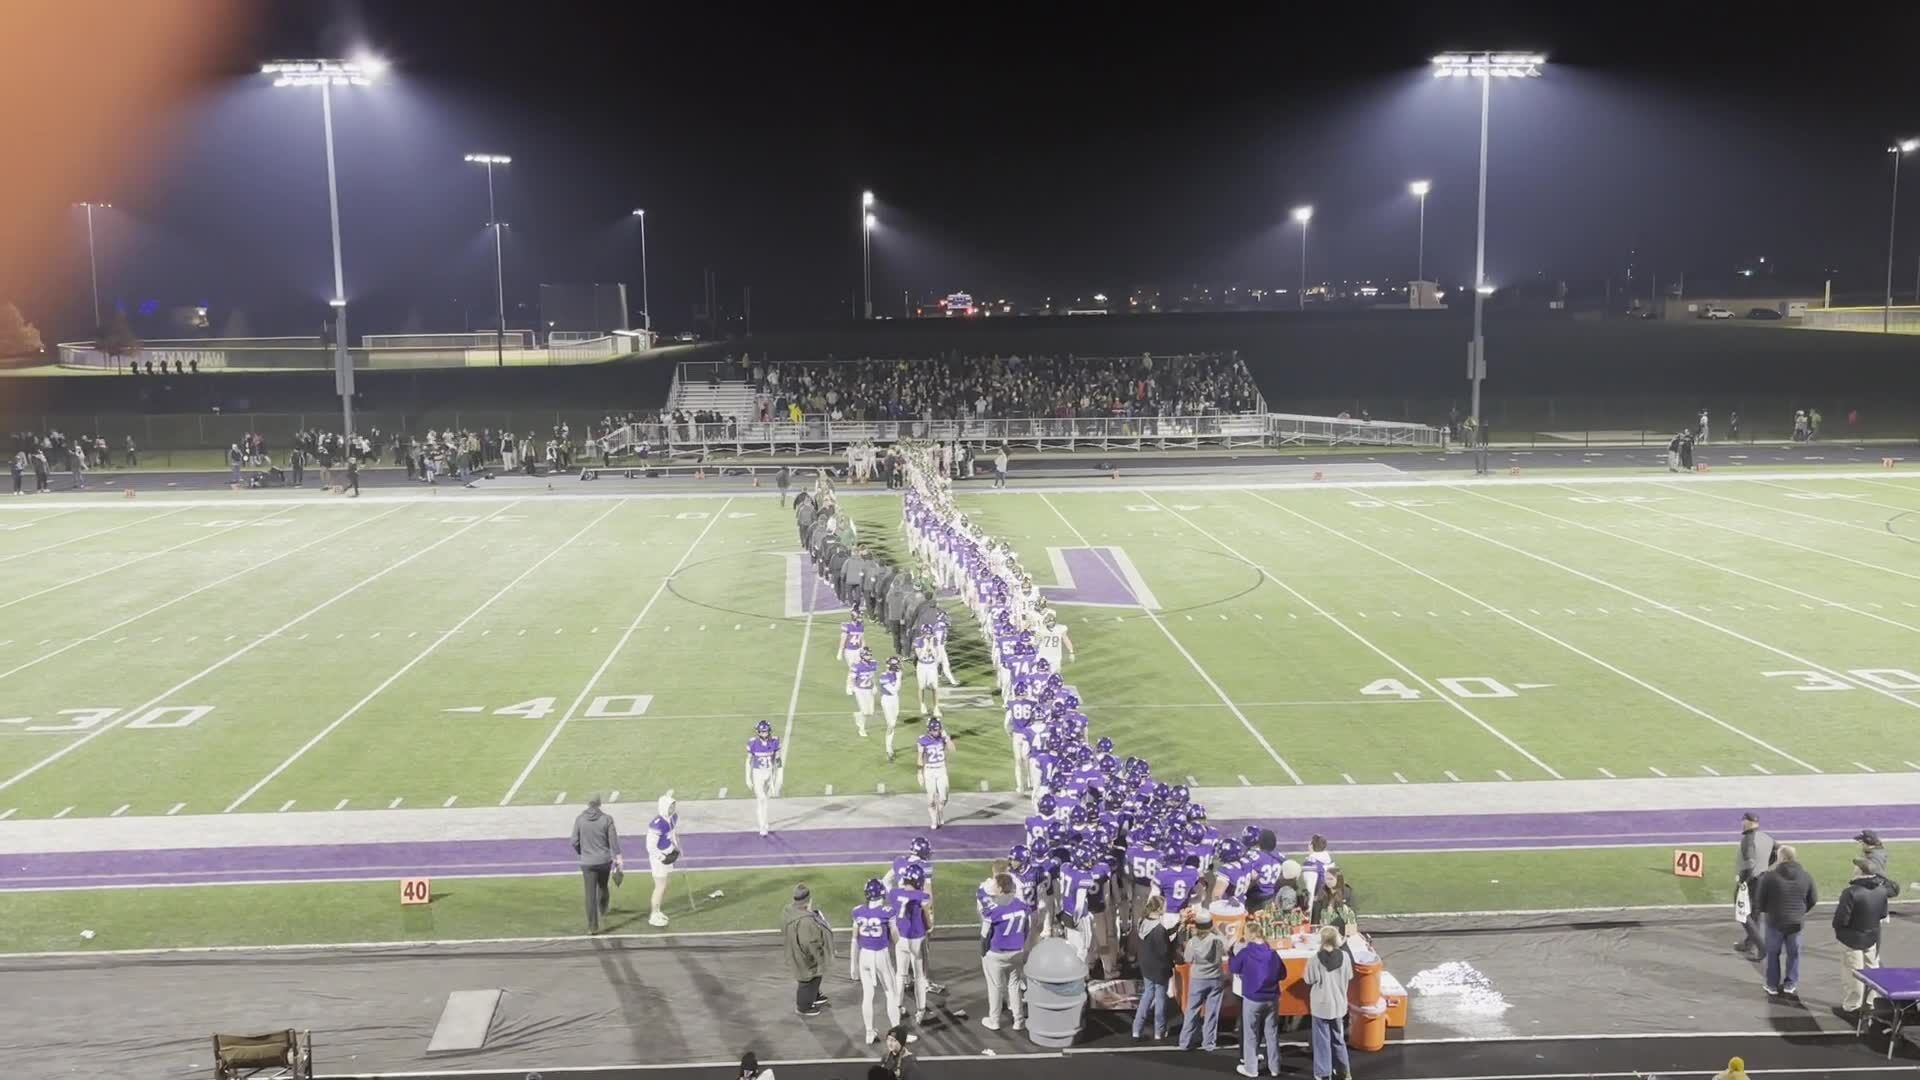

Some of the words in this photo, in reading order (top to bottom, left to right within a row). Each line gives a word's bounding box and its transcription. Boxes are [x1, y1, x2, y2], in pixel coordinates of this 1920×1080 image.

[1043, 635, 1060, 648] 78
[1359, 676, 1520, 699] 40
[1760, 669, 1920, 691] 30
[492, 695, 655, 719] 40
[1012, 703, 1032, 720] 86
[24, 705, 217, 732] 30
[928, 747, 945, 762] 25
[1133, 856, 1157, 880] 58
[1677, 853, 1700, 872] 40
[1260, 863, 1282, 885] 33
[403, 881, 427, 901] 40
[1173, 879, 1187, 900] 6
[897, 895, 910, 919] 7
[1002, 909, 1025, 936] 77
